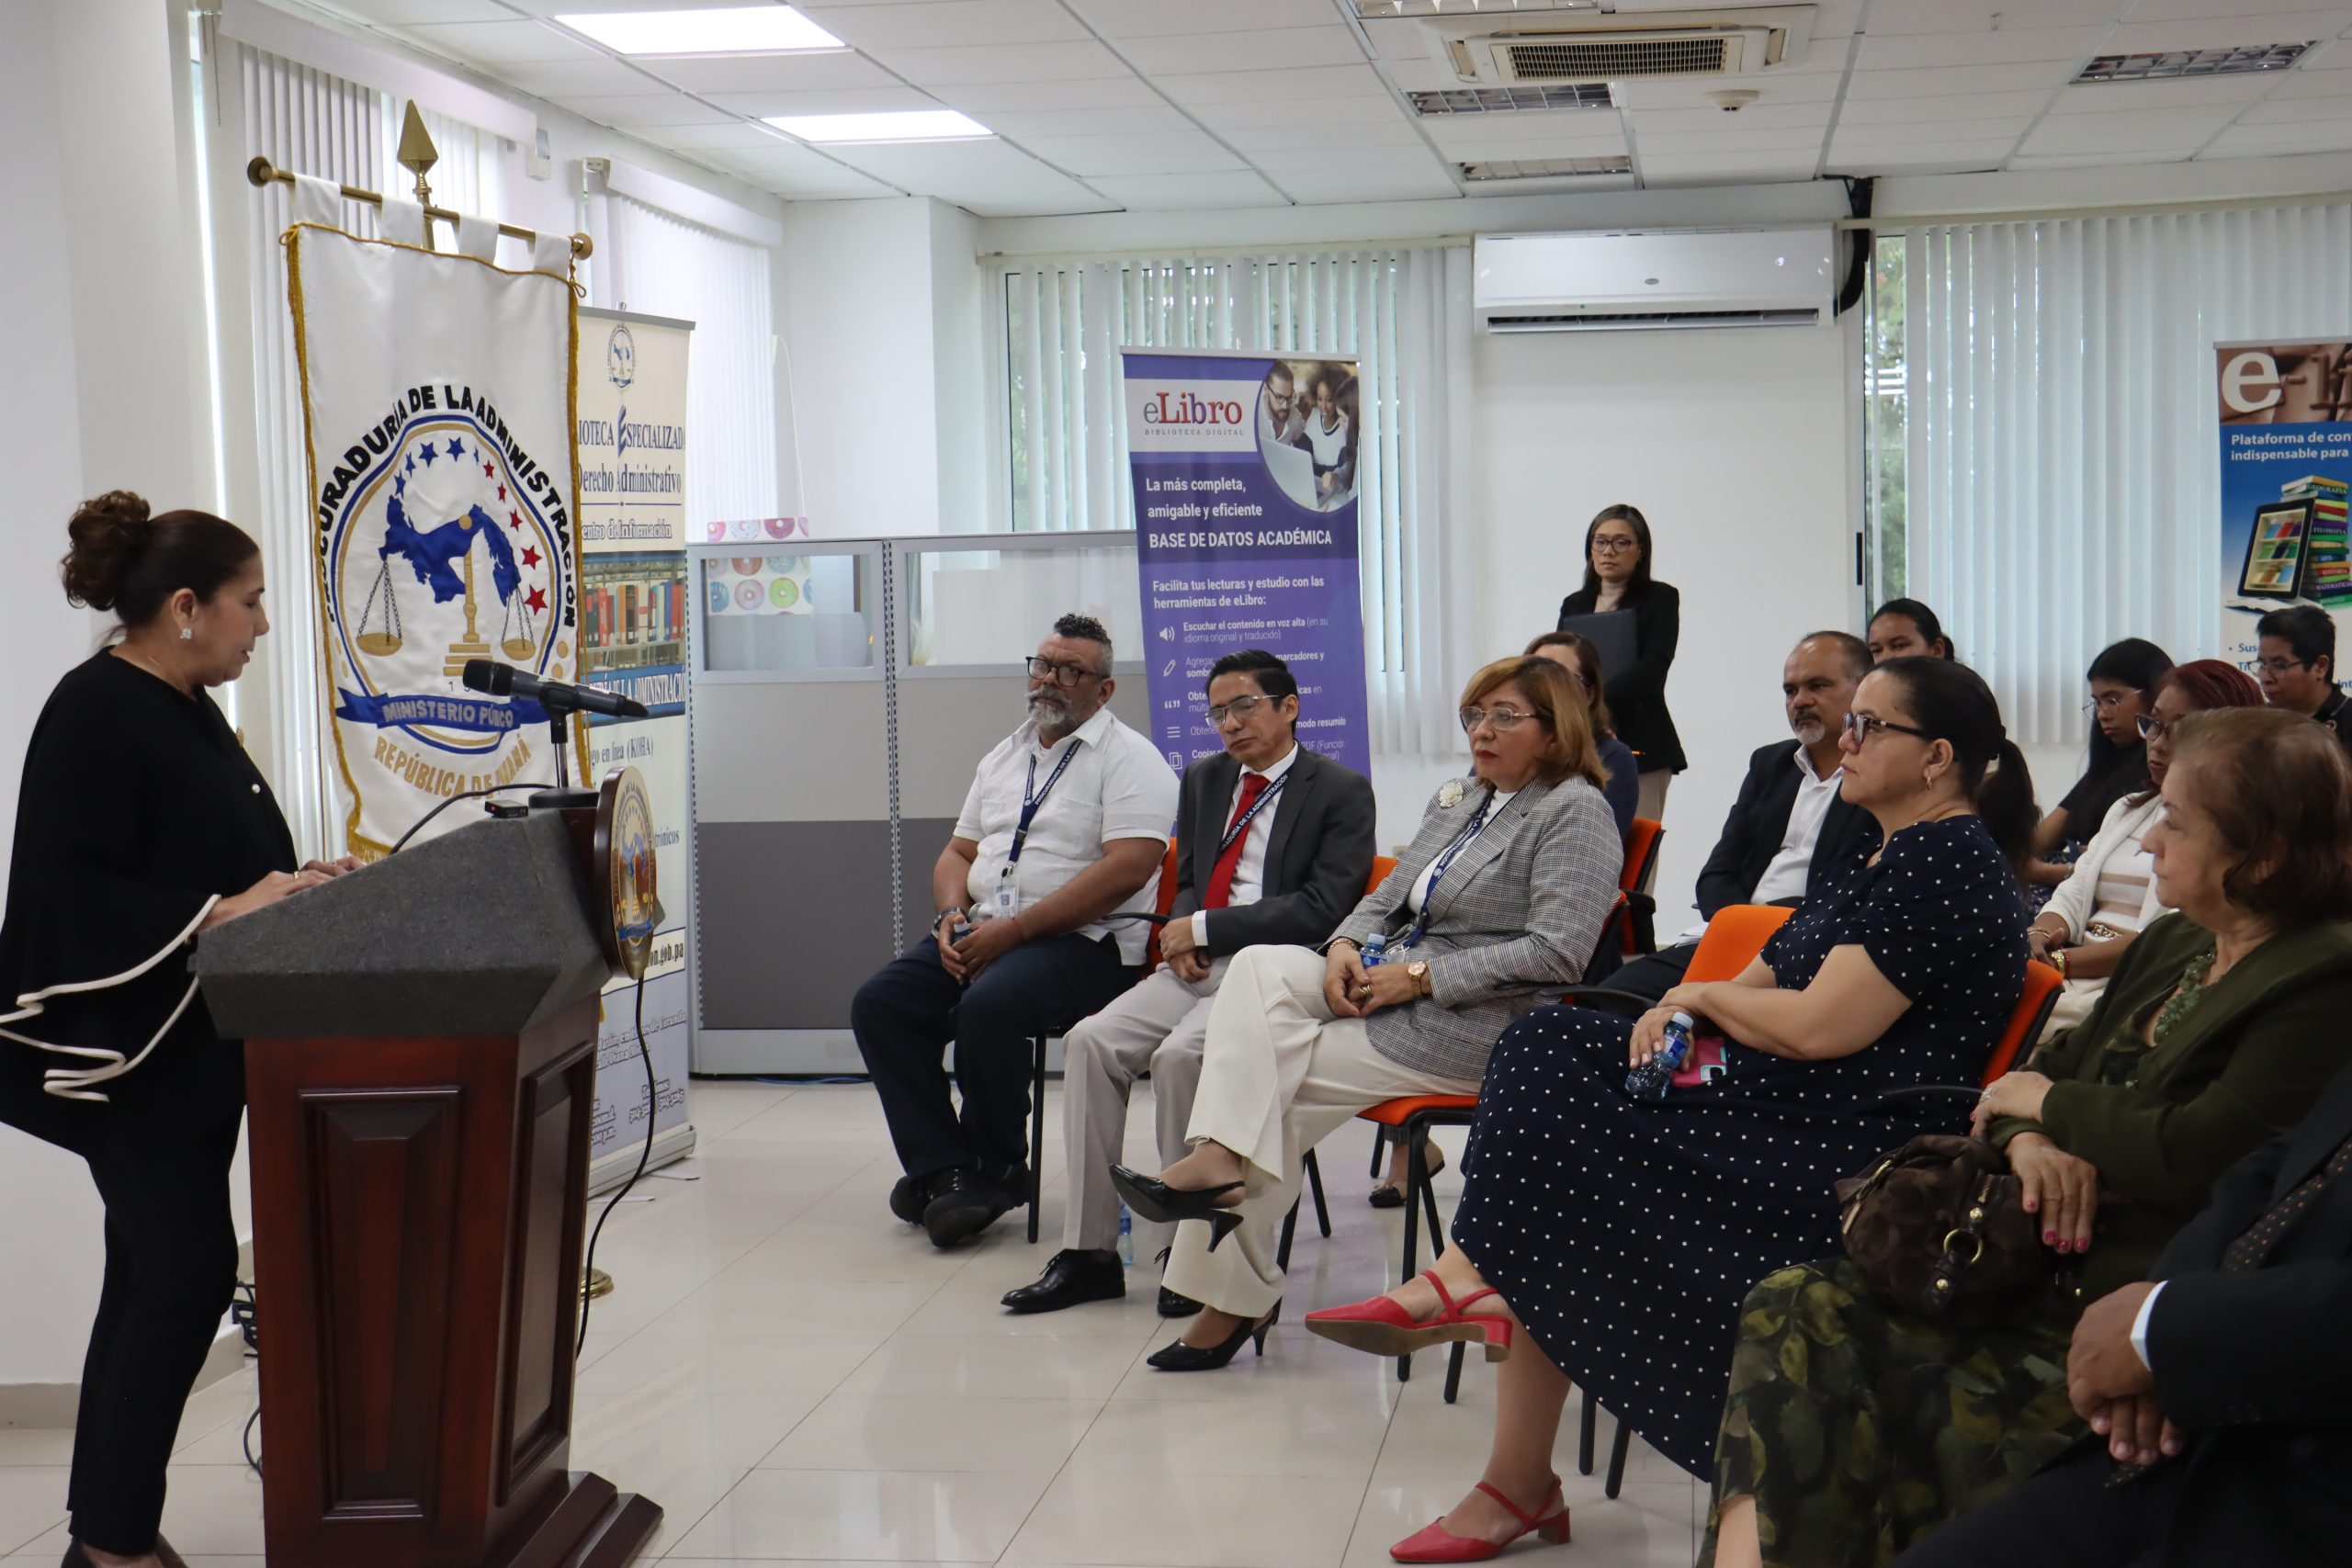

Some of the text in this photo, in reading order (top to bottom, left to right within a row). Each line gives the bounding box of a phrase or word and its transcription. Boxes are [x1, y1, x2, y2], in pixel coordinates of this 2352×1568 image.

[1143, 392, 1243, 424] eLibro
[579, 421, 614, 446] IOTECA
[2232, 432, 2352, 446] Plataforma de con
[2232, 448, 2349, 462] indispensable para
[616, 462, 682, 493] Administrativo
[1146, 478, 1247, 493] La más completa,
[319, 385, 575, 627] CURADURÍA DE LA ADMINISTRACIÓN
[1148, 503, 1262, 521] amigable y eficiente
[581, 520, 605, 540] entro
[616, 518, 673, 540] Información
[1149, 527, 1332, 548] BASE DE DATOS ACADÉMICA
[1153, 575, 1324, 592] Facilita tus lecturas y estudio con las
[1154, 594, 1266, 609] herramientas de eLibro:
[1183, 620, 1216, 631] Escuchar
[1218, 620, 1226, 630] el
[1227, 619, 1264, 629] contenido
[1277, 619, 1290, 628] voz
[1292, 618, 1306, 626] alta
[1306, 617, 1318, 626] (en
[1183, 629, 1282, 643] idioma original y traducido)
[1275, 651, 1318, 661] marcadores
[1319, 652, 1324, 661] y
[2238, 643, 2258, 652] Sus
[1188, 692, 1208, 701] Obte
[382, 699, 474, 723] MINISTERIO
[1296, 718, 1316, 728] modo
[375, 735, 464, 797] REPÚBLICA
[471, 775, 493, 800] DE
[1238, 818, 1248, 827] DE
[1246, 811, 1253, 819] LA
[1252, 774, 1288, 813] ADMINISTRACIÓN
[654, 828, 680, 848] trónicos
[648, 943, 684, 967] on.gob.pa
